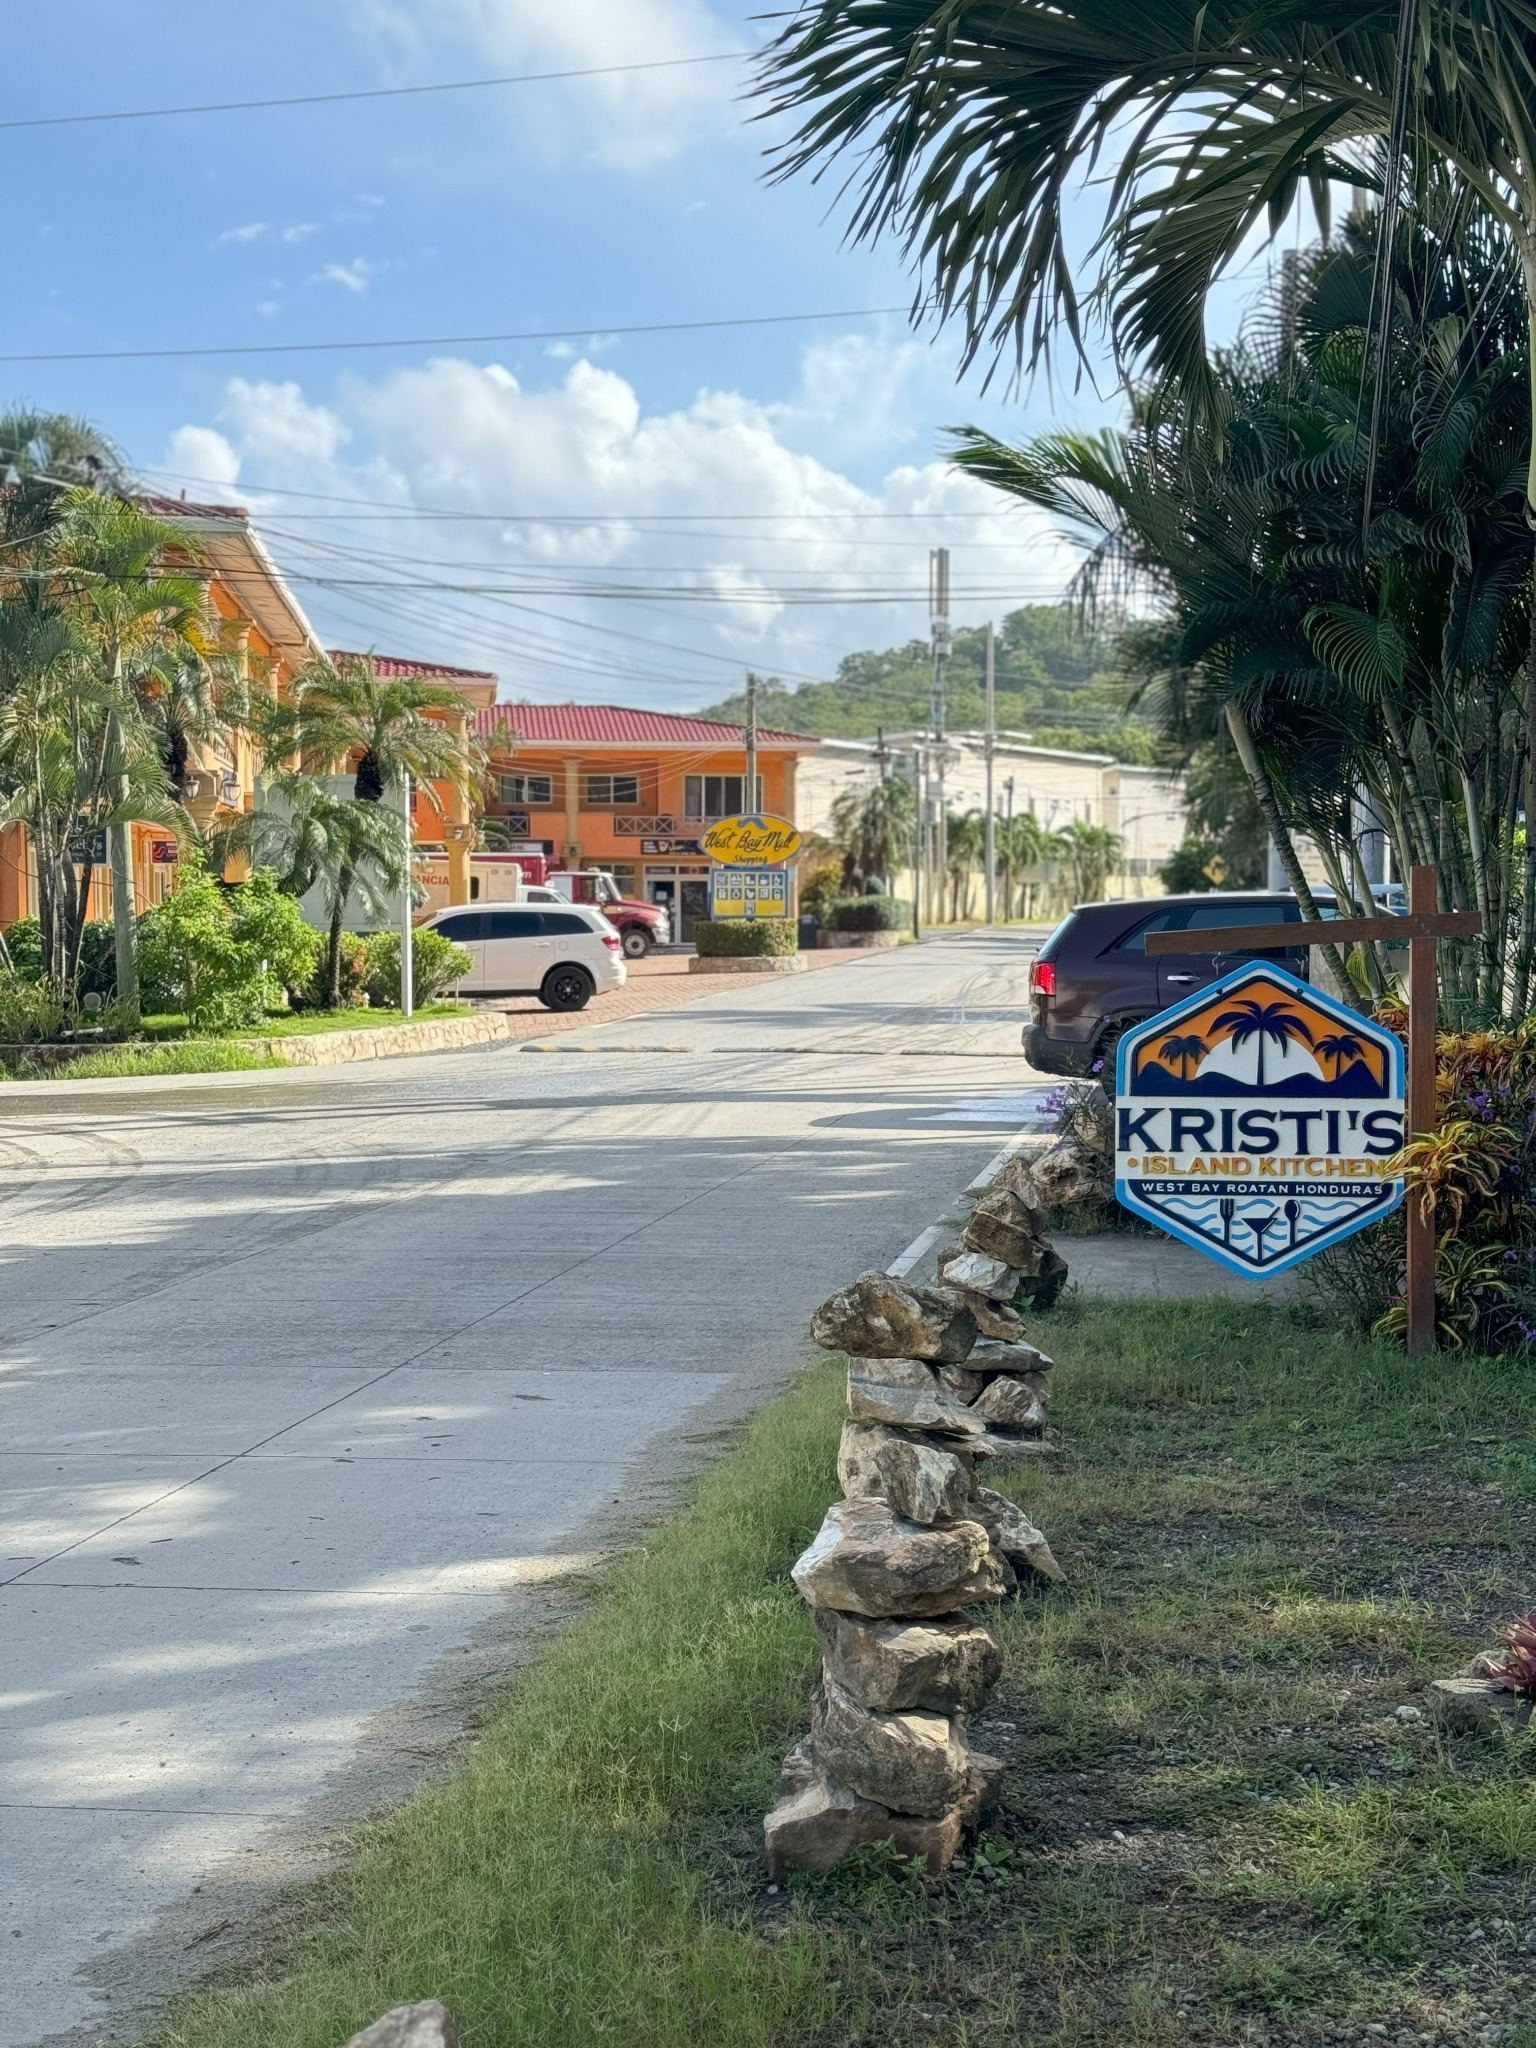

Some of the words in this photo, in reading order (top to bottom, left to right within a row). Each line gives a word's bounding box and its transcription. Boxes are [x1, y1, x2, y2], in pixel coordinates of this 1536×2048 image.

[705, 828, 737, 848] West
[736, 830, 765, 853] Bay
[733, 854, 768, 865] Shopping
[1117, 1107, 1404, 1155] KRISTI'S
[1142, 1155, 1251, 1175] ISLAND
[1259, 1156, 1386, 1177] KITCHEN
[1141, 1182, 1185, 1192] WEST
[1191, 1183, 1220, 1193] BAY
[1226, 1183, 1289, 1194] ROATAN
[1295, 1184, 1383, 1195] HONDURAS
